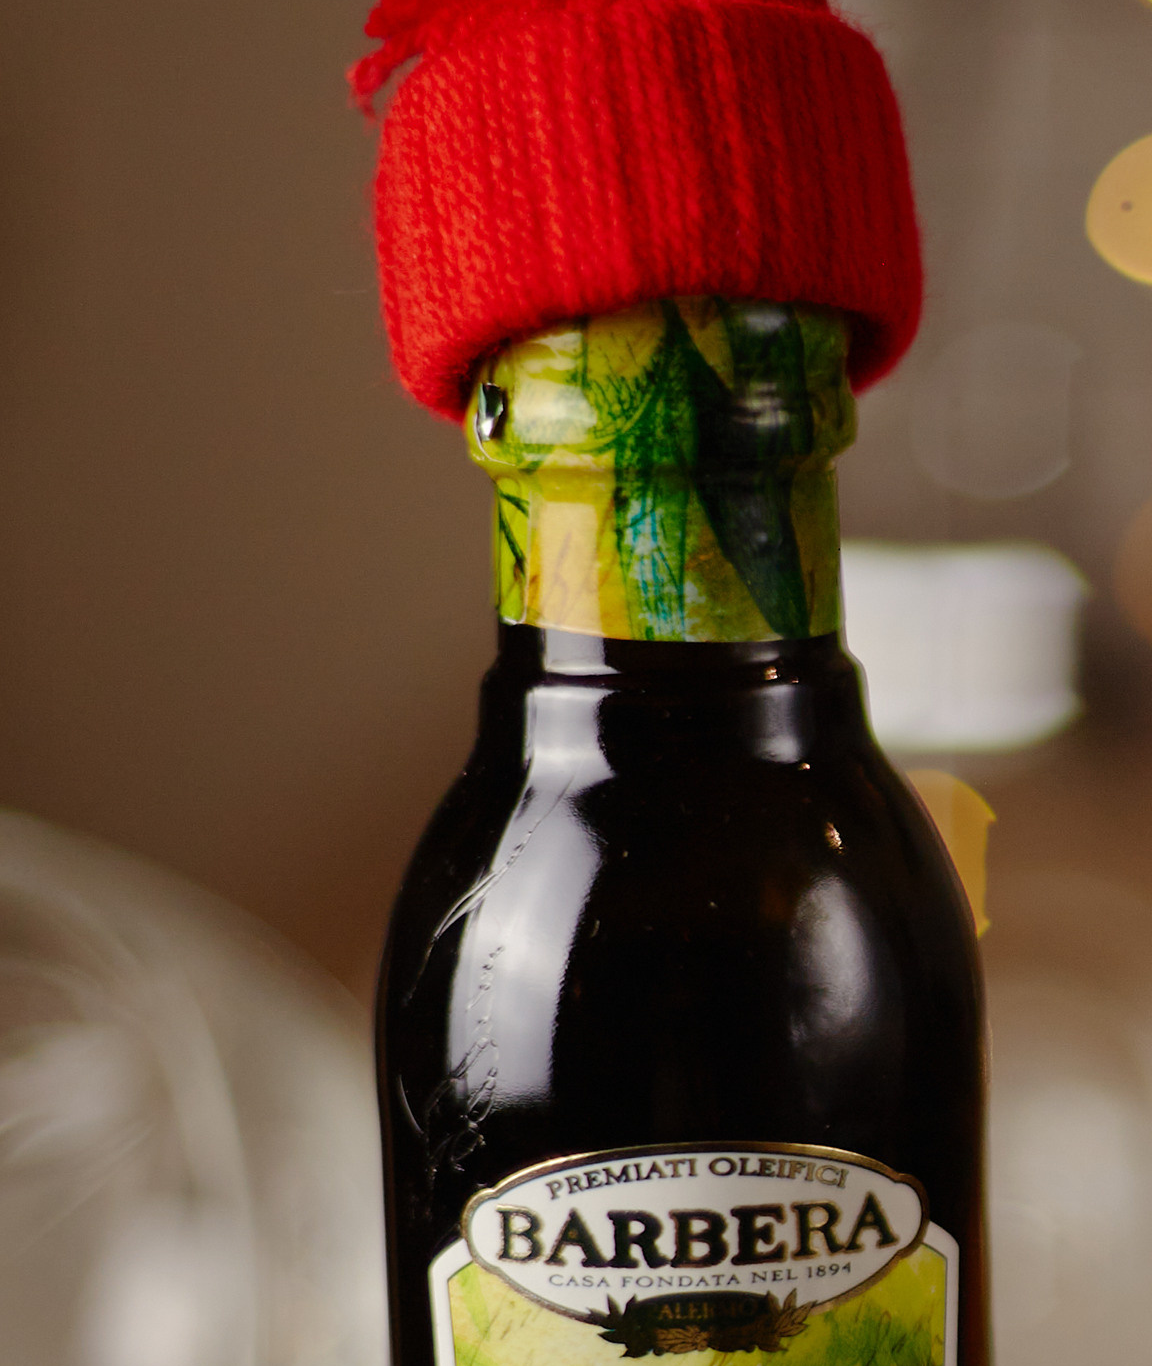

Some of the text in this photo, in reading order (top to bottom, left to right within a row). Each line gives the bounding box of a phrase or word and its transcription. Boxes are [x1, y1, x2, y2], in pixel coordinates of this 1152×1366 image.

[545, 1156, 849, 1200] PREMIATI OLEIFICI
[496, 1191, 899, 1270] BARBERA
[548, 1261, 853, 1289] CASA FONDATA NEL 1894
